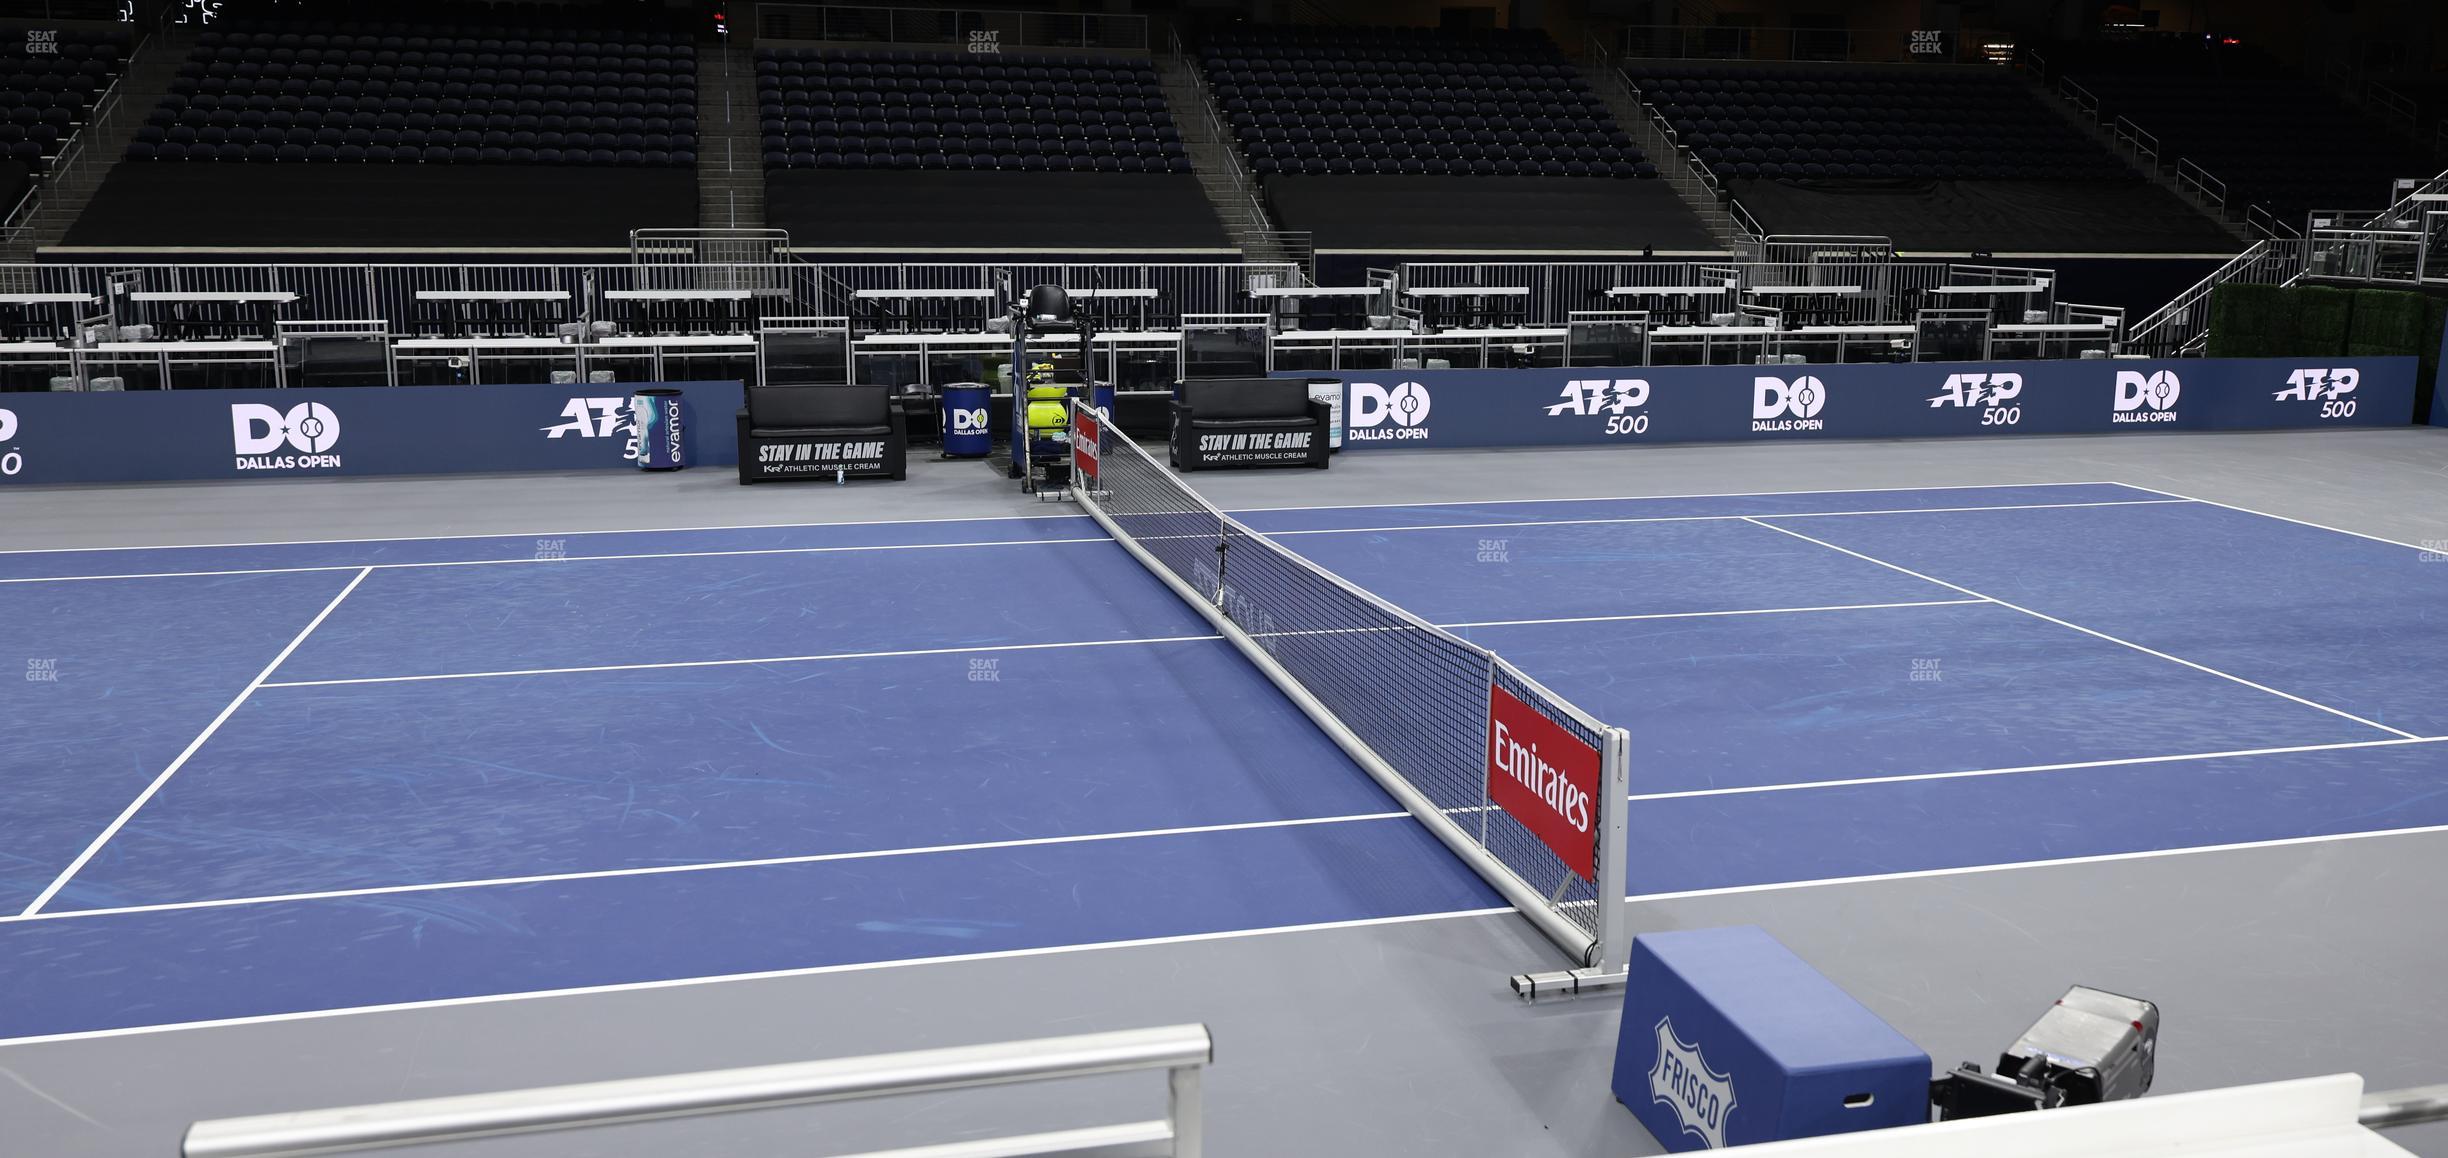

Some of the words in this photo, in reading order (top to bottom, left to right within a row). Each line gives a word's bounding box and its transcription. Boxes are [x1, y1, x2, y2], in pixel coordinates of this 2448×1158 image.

[1925, 373, 2023, 408] ATP
[2272, 368, 2360, 401] ATP
[1542, 379, 1650, 416] ATP
[1981, 407, 2020, 425] 500
[2113, 412, 2148, 423] DALLAS
[2150, 412, 2176, 422] OPEN
[2320, 400, 2356, 418] 500
[668, 400, 681, 462] evamor
[1349, 429, 1393, 440] DALLAS
[1396, 428, 1428, 439] OPEN
[1605, 415, 1649, 434] 500
[1752, 421, 1792, 431] DALLAS
[1793, 420, 1823, 430] OPEN
[1076, 427, 1098, 461] Emirates
[1199, 434, 1231, 451] STAY
[1231, 434, 1247, 450] IN
[1249, 433, 1273, 450] THE
[1274, 432, 1312, 449] GAME
[759, 444, 794, 462] STAY
[795, 444, 812, 460] IN
[814, 443, 841, 460] THE
[842, 442, 885, 459] GAME
[236, 456, 295, 470] DALLAS
[298, 455, 341, 468] OPEN
[1494, 719, 1589, 833] Emirates
[1662, 1048, 1719, 1131] FRISCO
